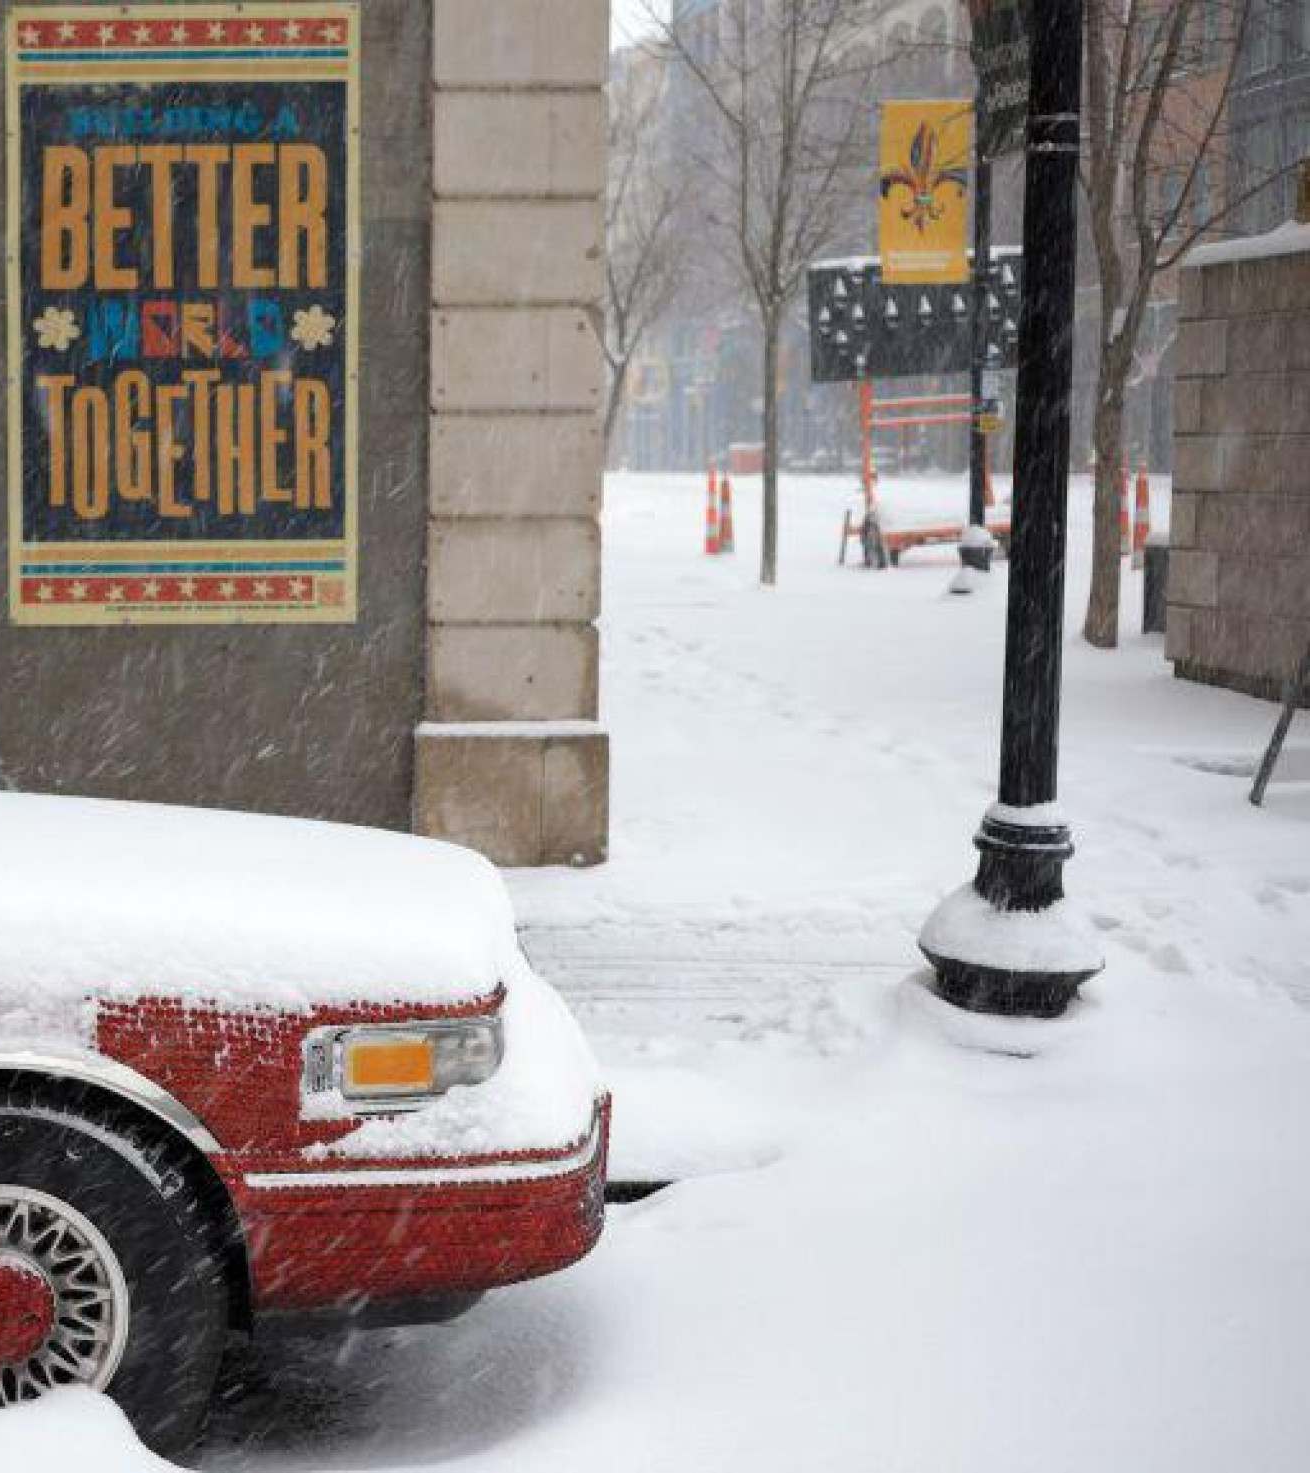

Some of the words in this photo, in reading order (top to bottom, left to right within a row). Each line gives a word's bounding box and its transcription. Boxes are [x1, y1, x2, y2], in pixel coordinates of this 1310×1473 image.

[272, 103, 301, 139] A
[41, 143, 329, 289] BETTER
[86, 299, 288, 358] WORLD
[36, 368, 332, 520] TOGETHER
